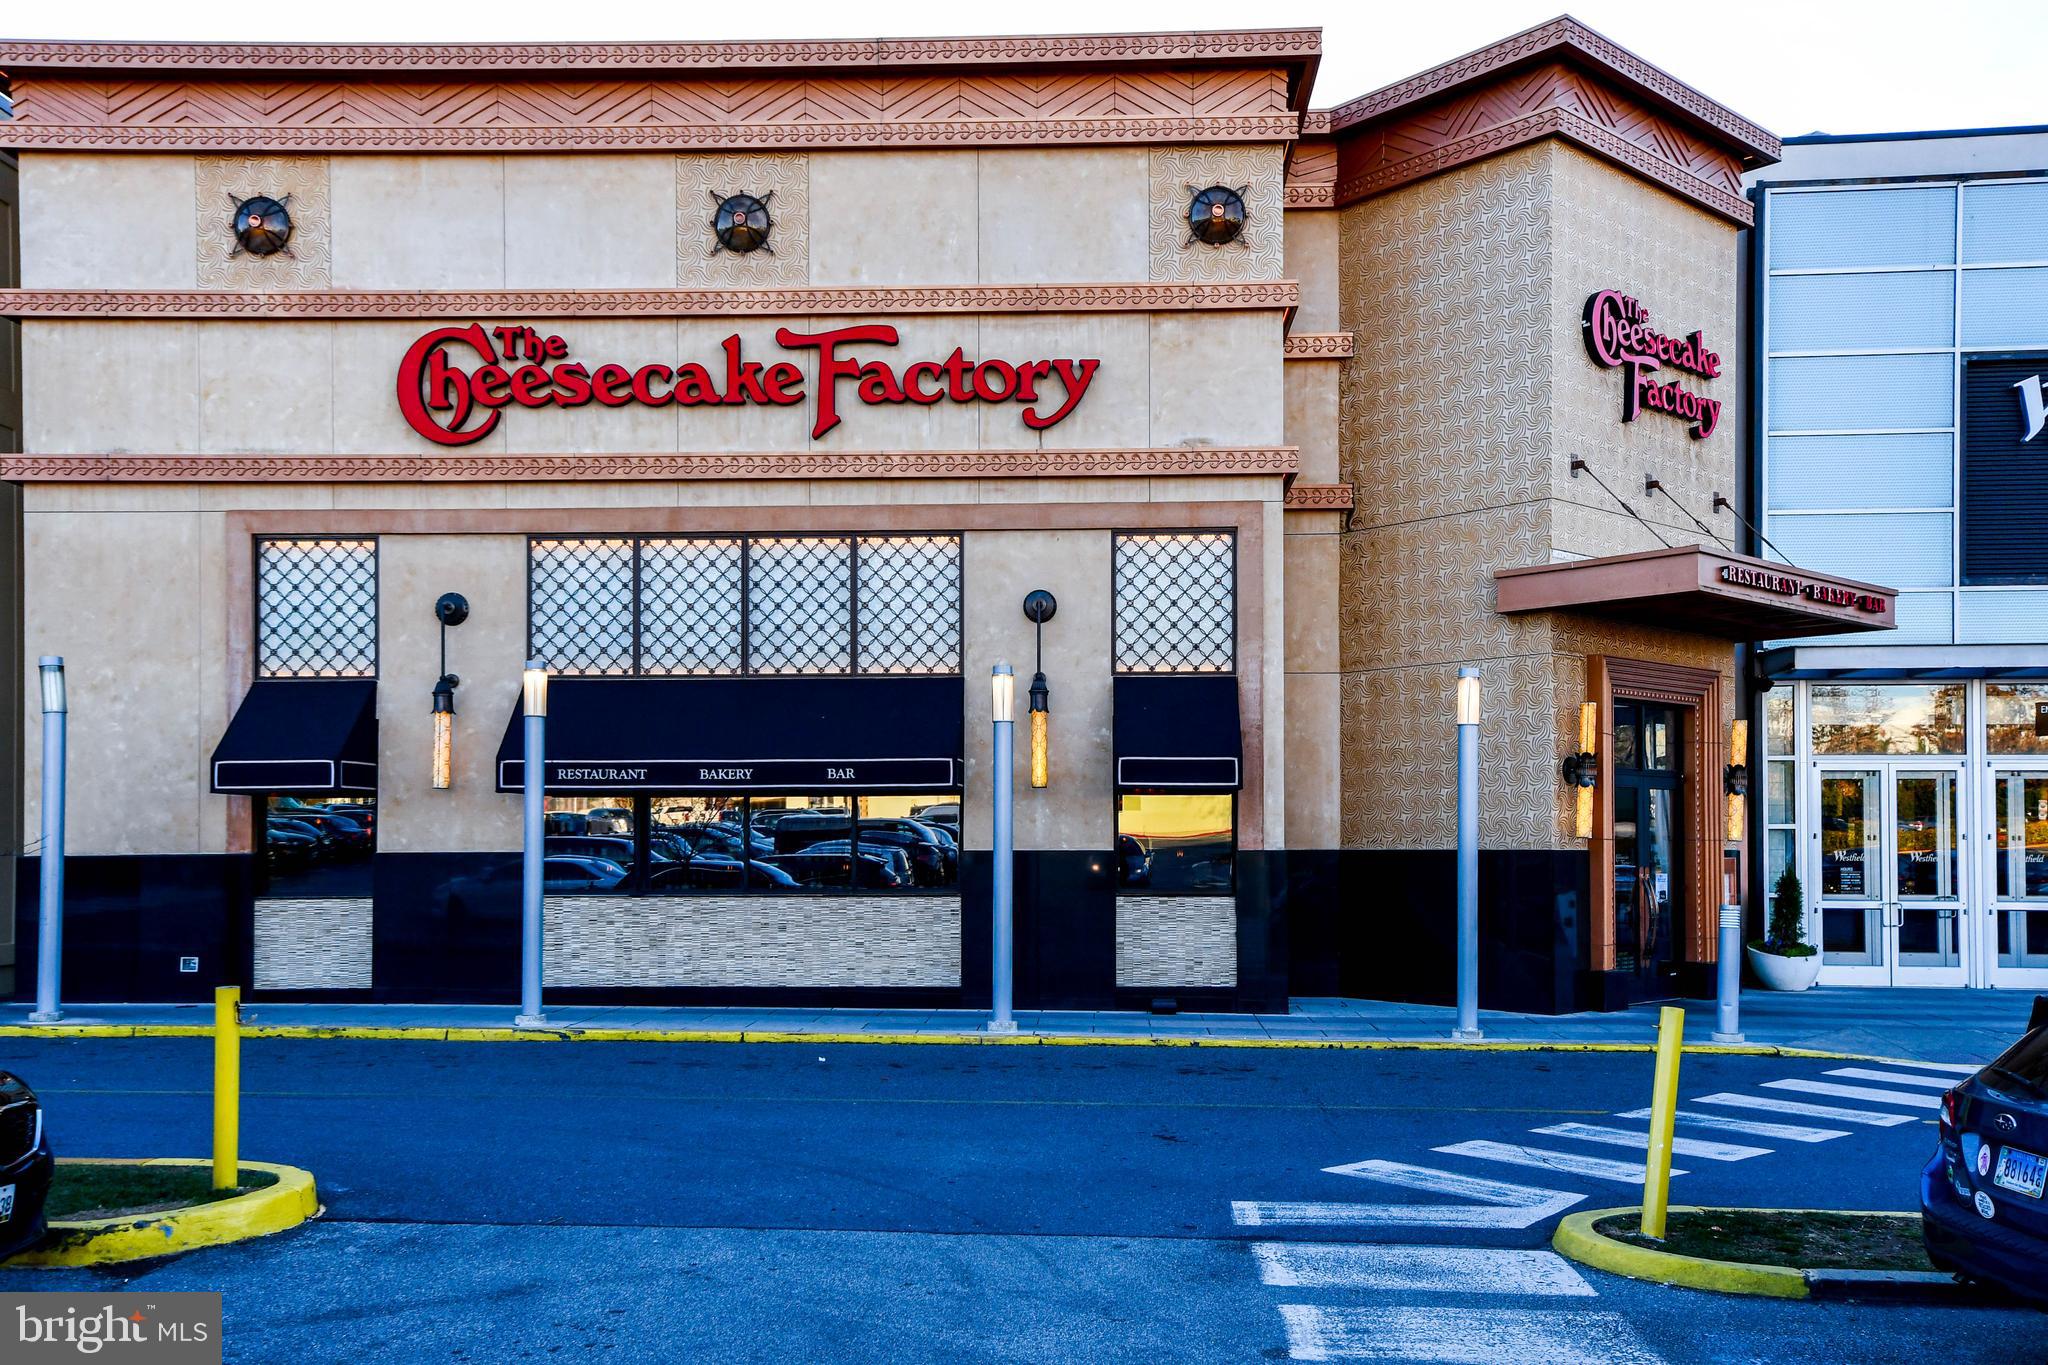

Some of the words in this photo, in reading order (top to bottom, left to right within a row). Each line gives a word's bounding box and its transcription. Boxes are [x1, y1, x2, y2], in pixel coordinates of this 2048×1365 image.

[1623, 295, 1650, 324] The
[491, 325, 568, 365] The
[1588, 288, 1722, 379] Cheesecake
[396, 322, 806, 446] Cheesecake
[775, 324, 1101, 440] Factory
[1620, 347, 1722, 439] Factory
[1728, 565, 1802, 596] RESTAURANT
[1813, 583, 1857, 607] BAKERY
[1866, 595, 1886, 613] BAR
[557, 768, 648, 780] RESTAURANT
[700, 768, 753, 780] BAKERY
[827, 767, 856, 780] BAR
[1910, 851, 1938, 863] Westfie
